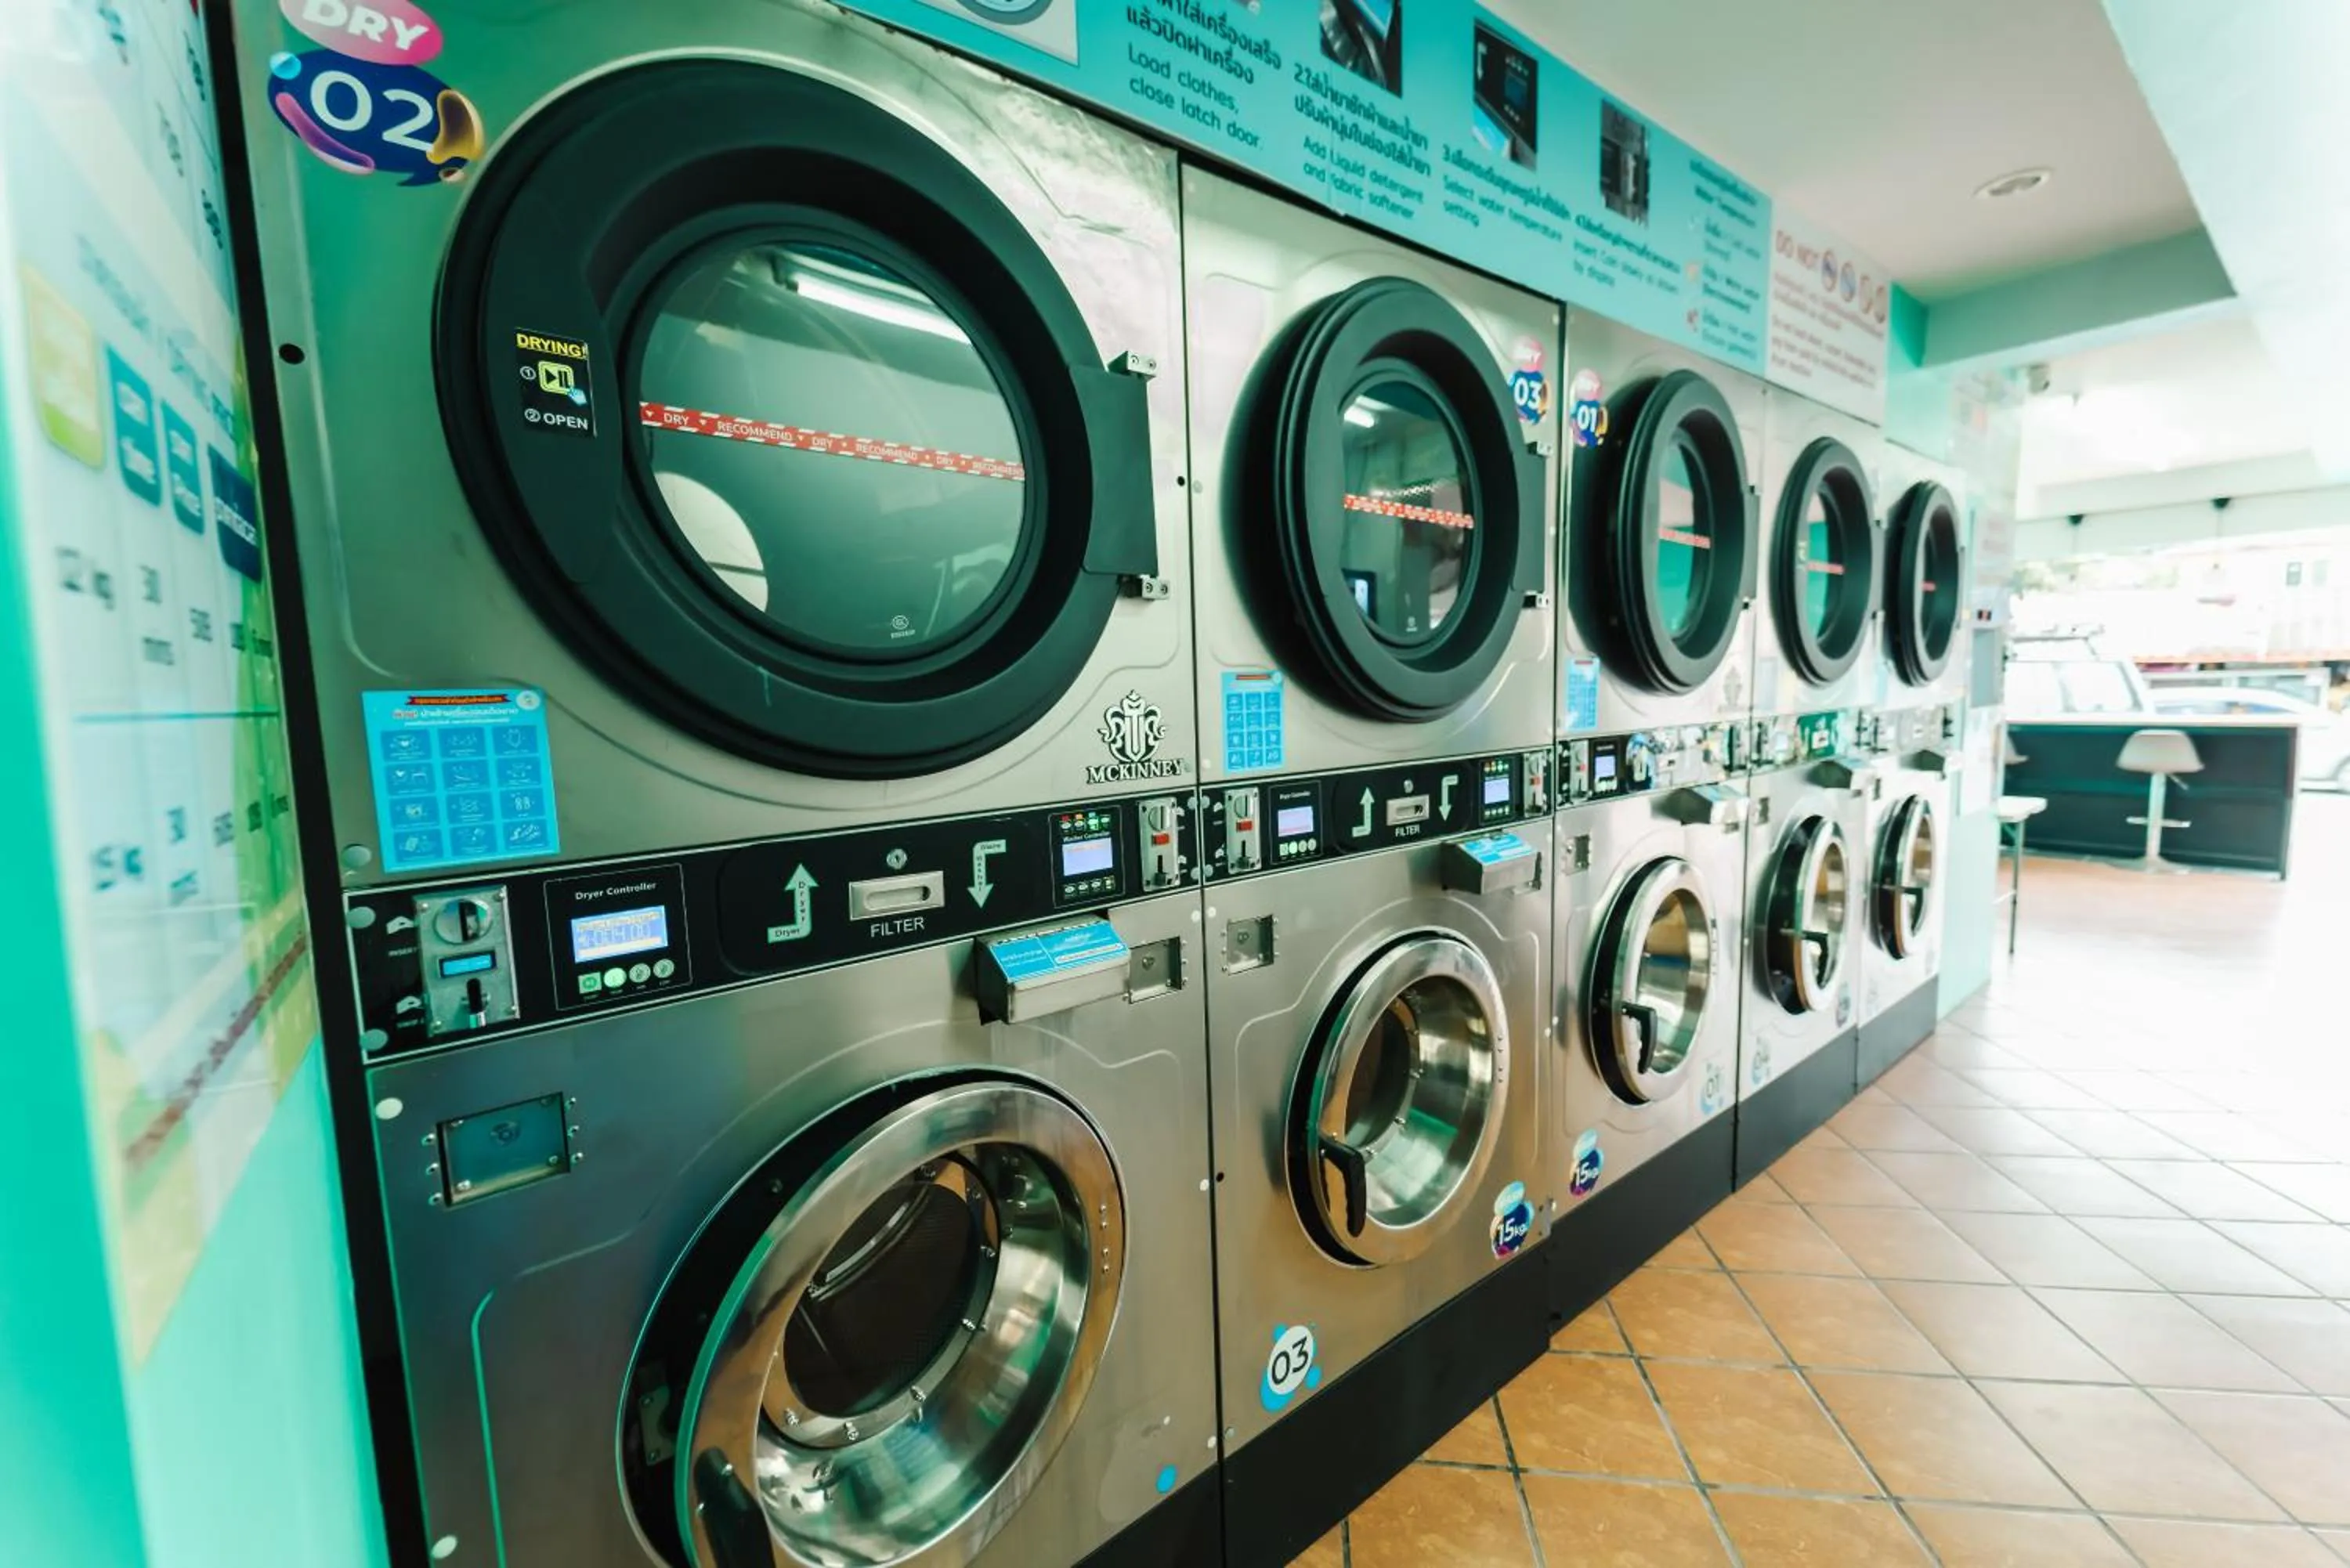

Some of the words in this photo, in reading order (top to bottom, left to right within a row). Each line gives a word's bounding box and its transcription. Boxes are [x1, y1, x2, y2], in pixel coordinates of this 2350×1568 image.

[302, 0, 429, 50] DRY
[1128, 42, 1170, 79] Load
[1177, 70, 1239, 114] clothes,
[310, 70, 433, 152] 02
[1130, 77, 1175, 109] close
[1181, 96, 1221, 130] latch
[1303, 135, 1326, 159] Add
[1369, 170, 1424, 204] detergent
[1303, 162, 1326, 183] and
[1514, 377, 1542, 410] 03
[544, 413, 588, 430] OPEN
[663, 413, 689, 425] DRY
[717, 421, 794, 442] RECOMMEND
[812, 435, 833, 449] DRY
[1577, 405, 1597, 432] 01
[1086, 757, 1184, 784] MCKINNEY
[1395, 824, 1420, 837] FILTER
[575, 890, 604, 900] Dryer
[606, 882, 656, 895] Controller
[775, 927, 800, 938] Dryer
[870, 916, 925, 938] FILTER
[1271, 1335, 1309, 1385] 03
